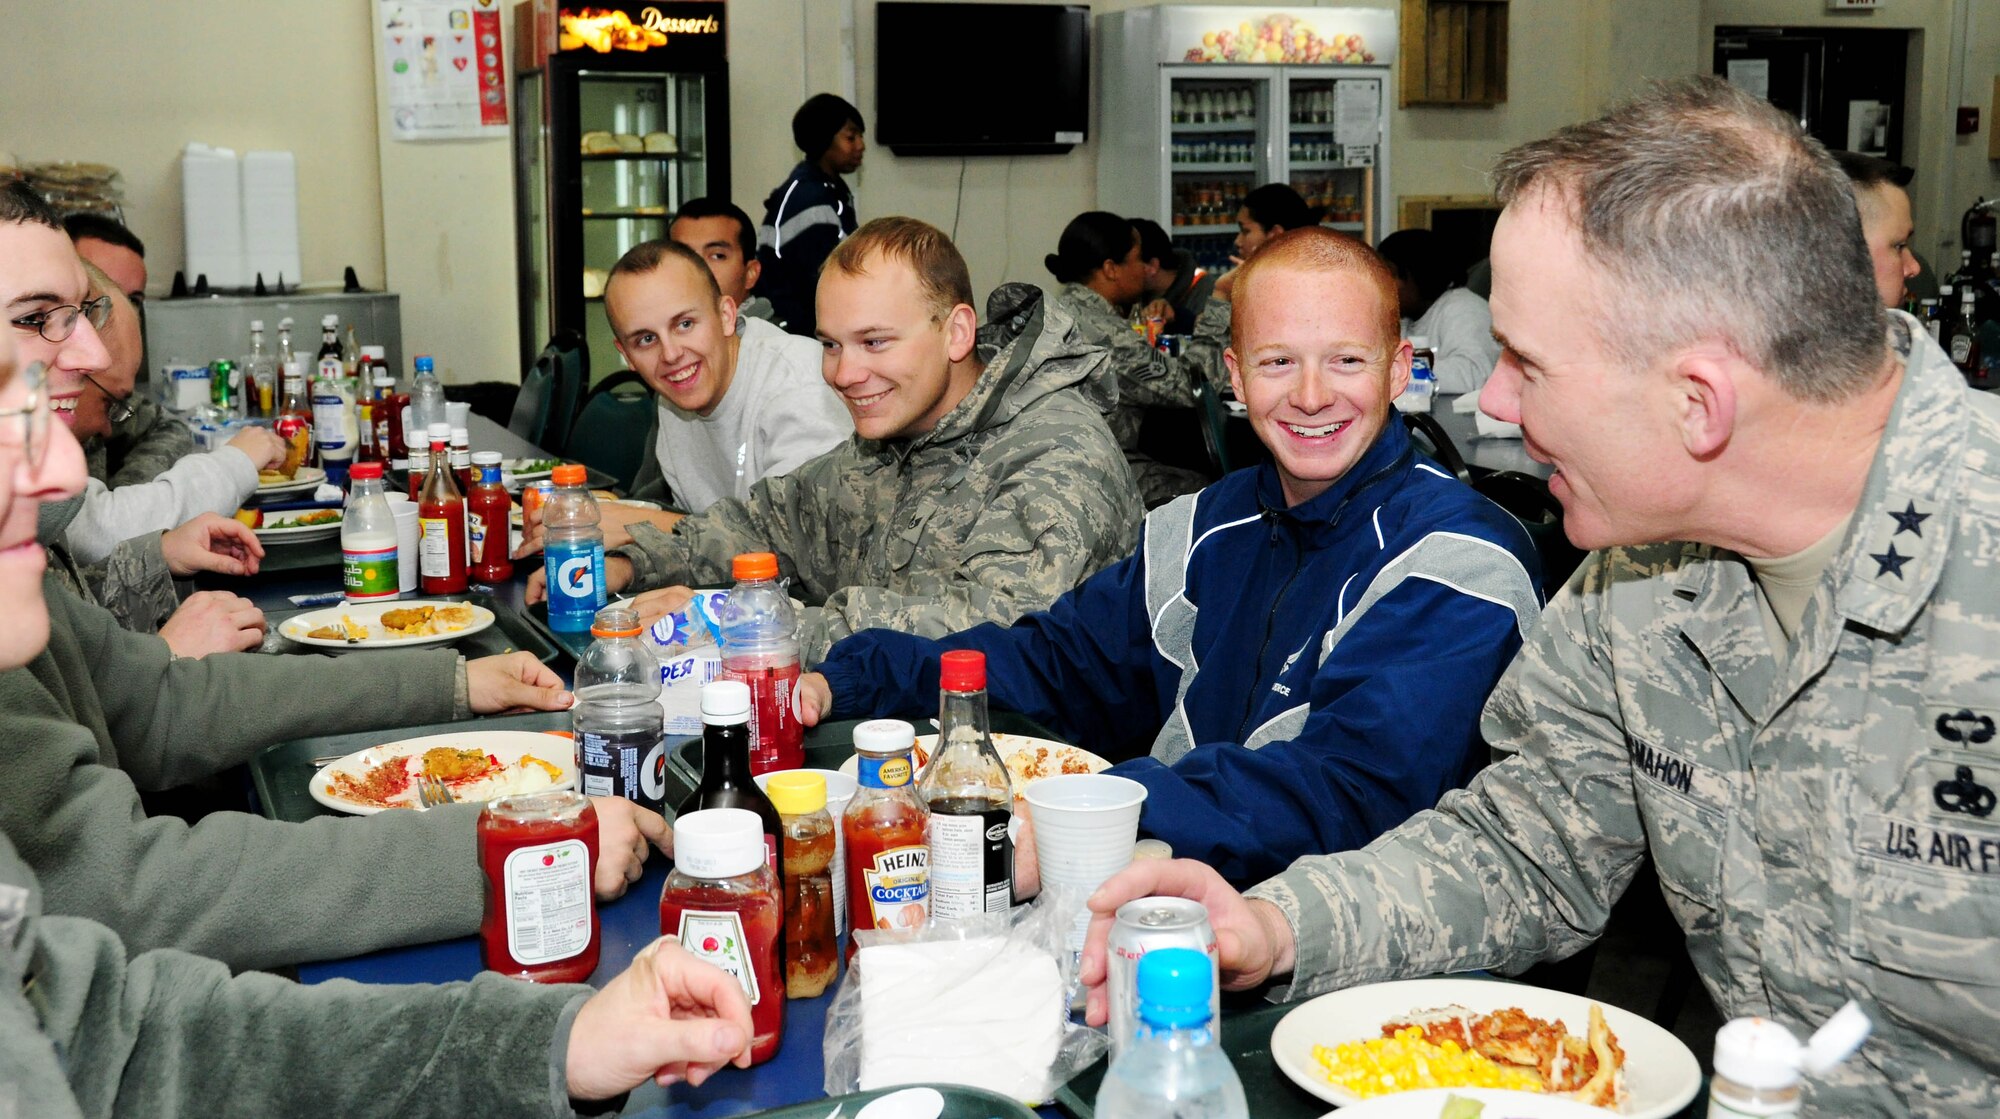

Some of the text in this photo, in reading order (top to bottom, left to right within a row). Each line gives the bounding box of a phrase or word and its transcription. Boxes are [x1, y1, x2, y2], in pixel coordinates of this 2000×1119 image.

[641, 6, 719, 34] Desserts
[558, 555, 594, 598] G
[883, 852, 926, 872] HEINZ
[1928, 831, 1975, 872] AIR
[1979, 838, 2000, 874] F
